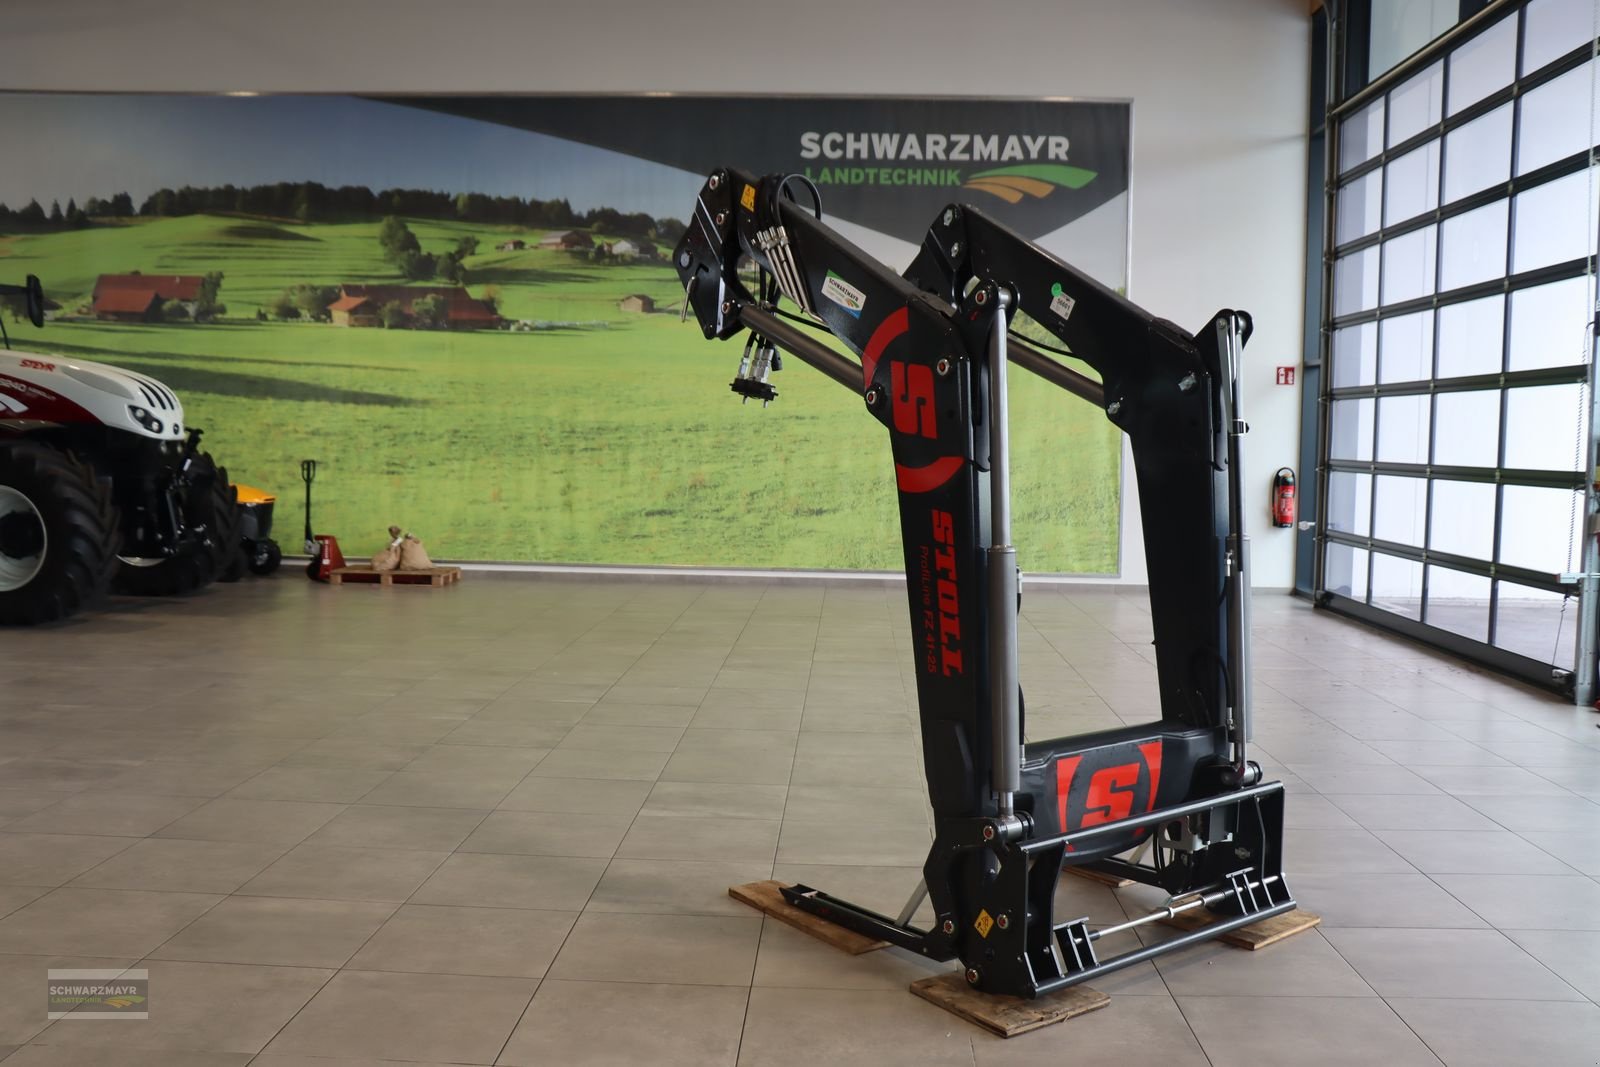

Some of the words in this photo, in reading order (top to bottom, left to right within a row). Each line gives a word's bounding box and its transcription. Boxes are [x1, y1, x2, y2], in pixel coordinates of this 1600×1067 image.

[800, 131, 1070, 161] SCHWARZMAYR
[804, 166, 961, 186] LANDTECHNIK
[932, 509, 963, 677] STOLL
